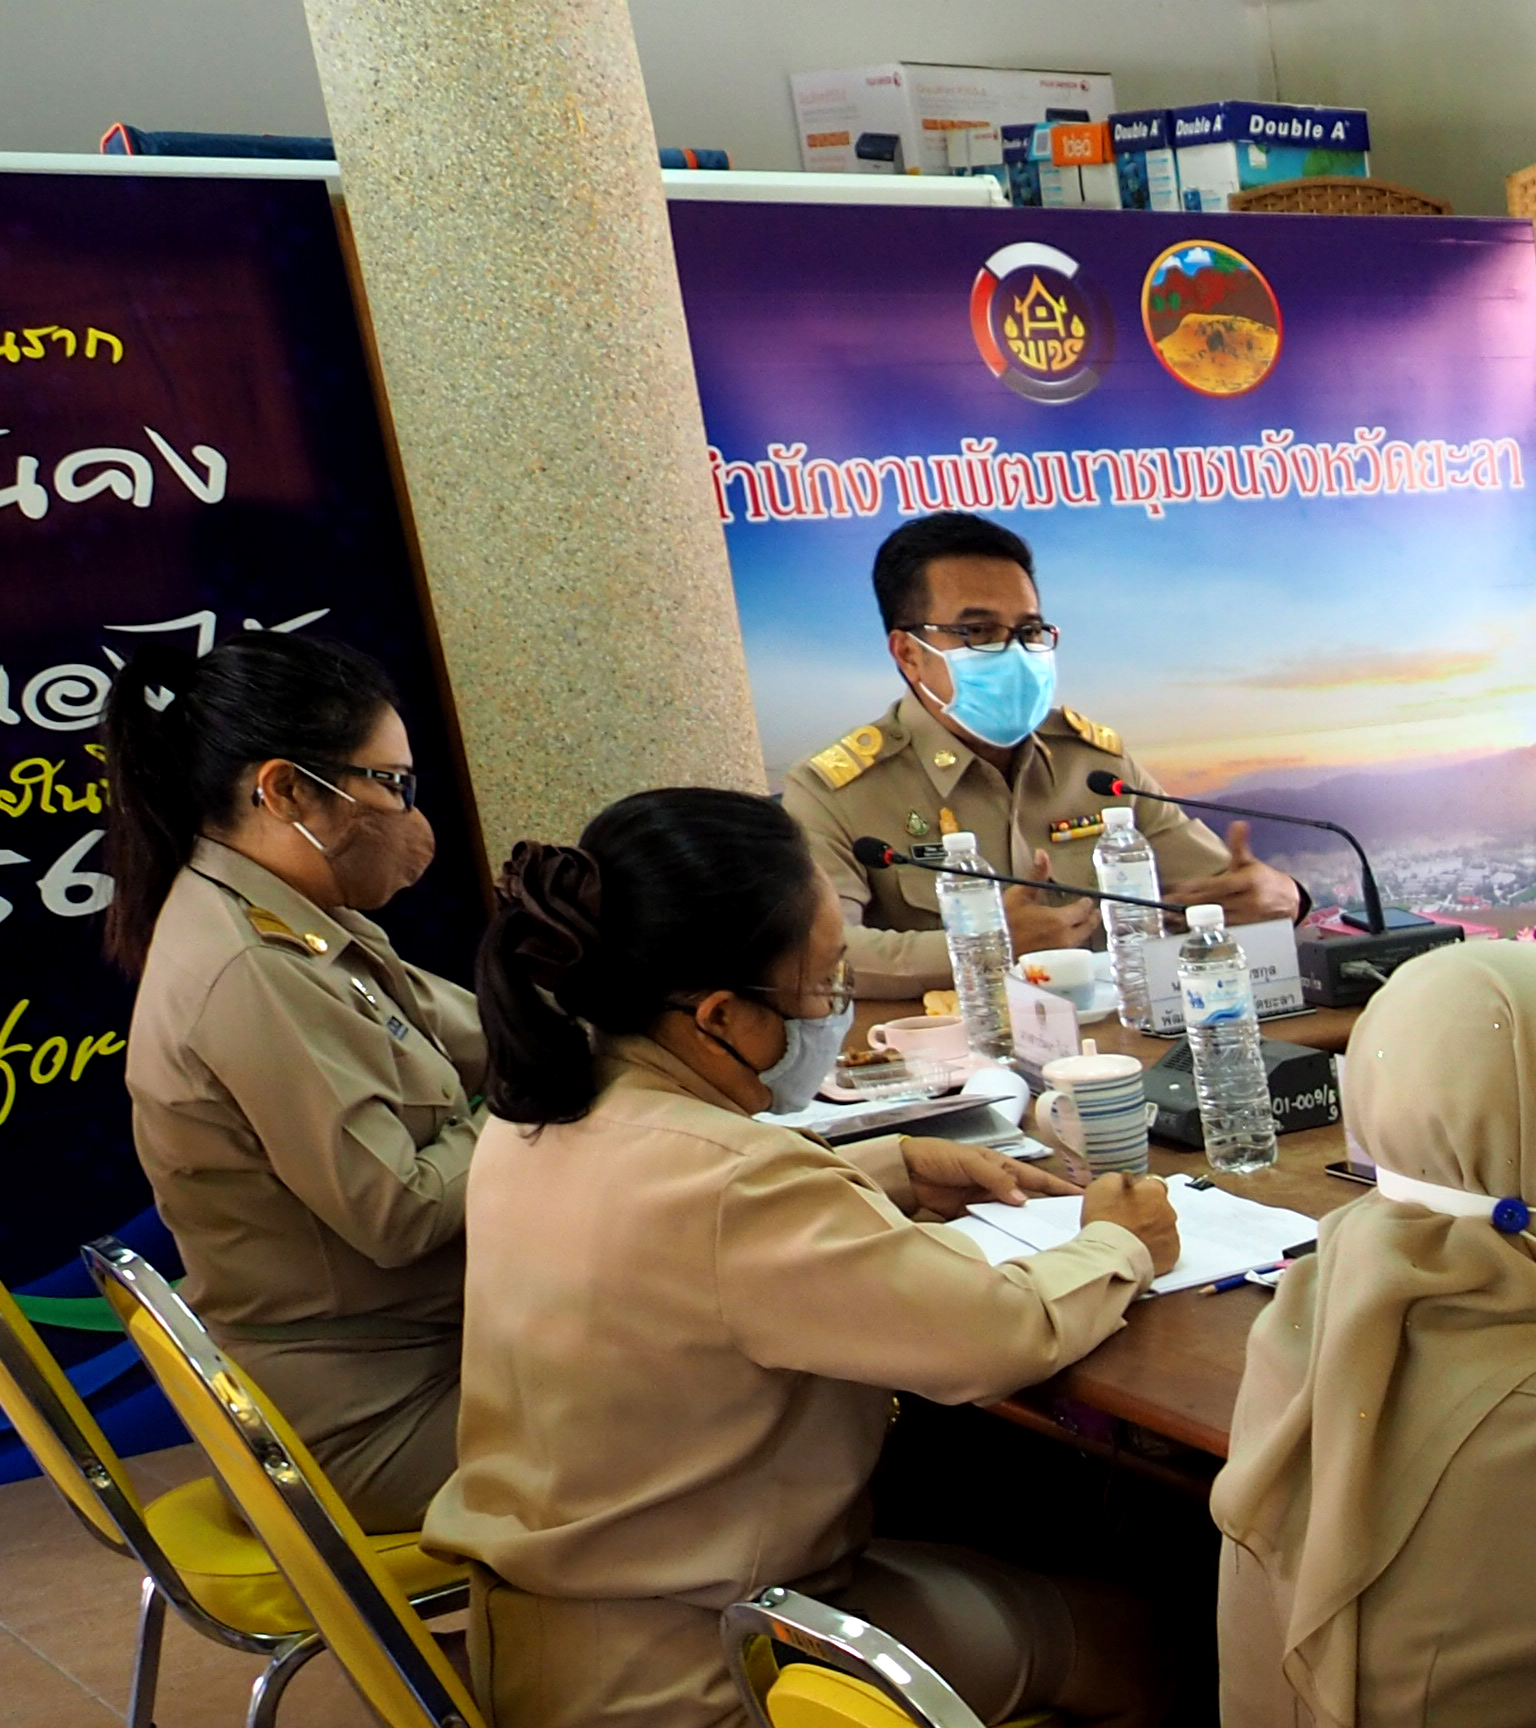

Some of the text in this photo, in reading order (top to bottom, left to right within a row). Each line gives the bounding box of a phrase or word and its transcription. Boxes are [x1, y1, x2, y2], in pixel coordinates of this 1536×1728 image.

[1115, 119, 1159, 142] Double A
[1176, 114, 1222, 137] Double A
[1250, 114, 1346, 140] Double A
